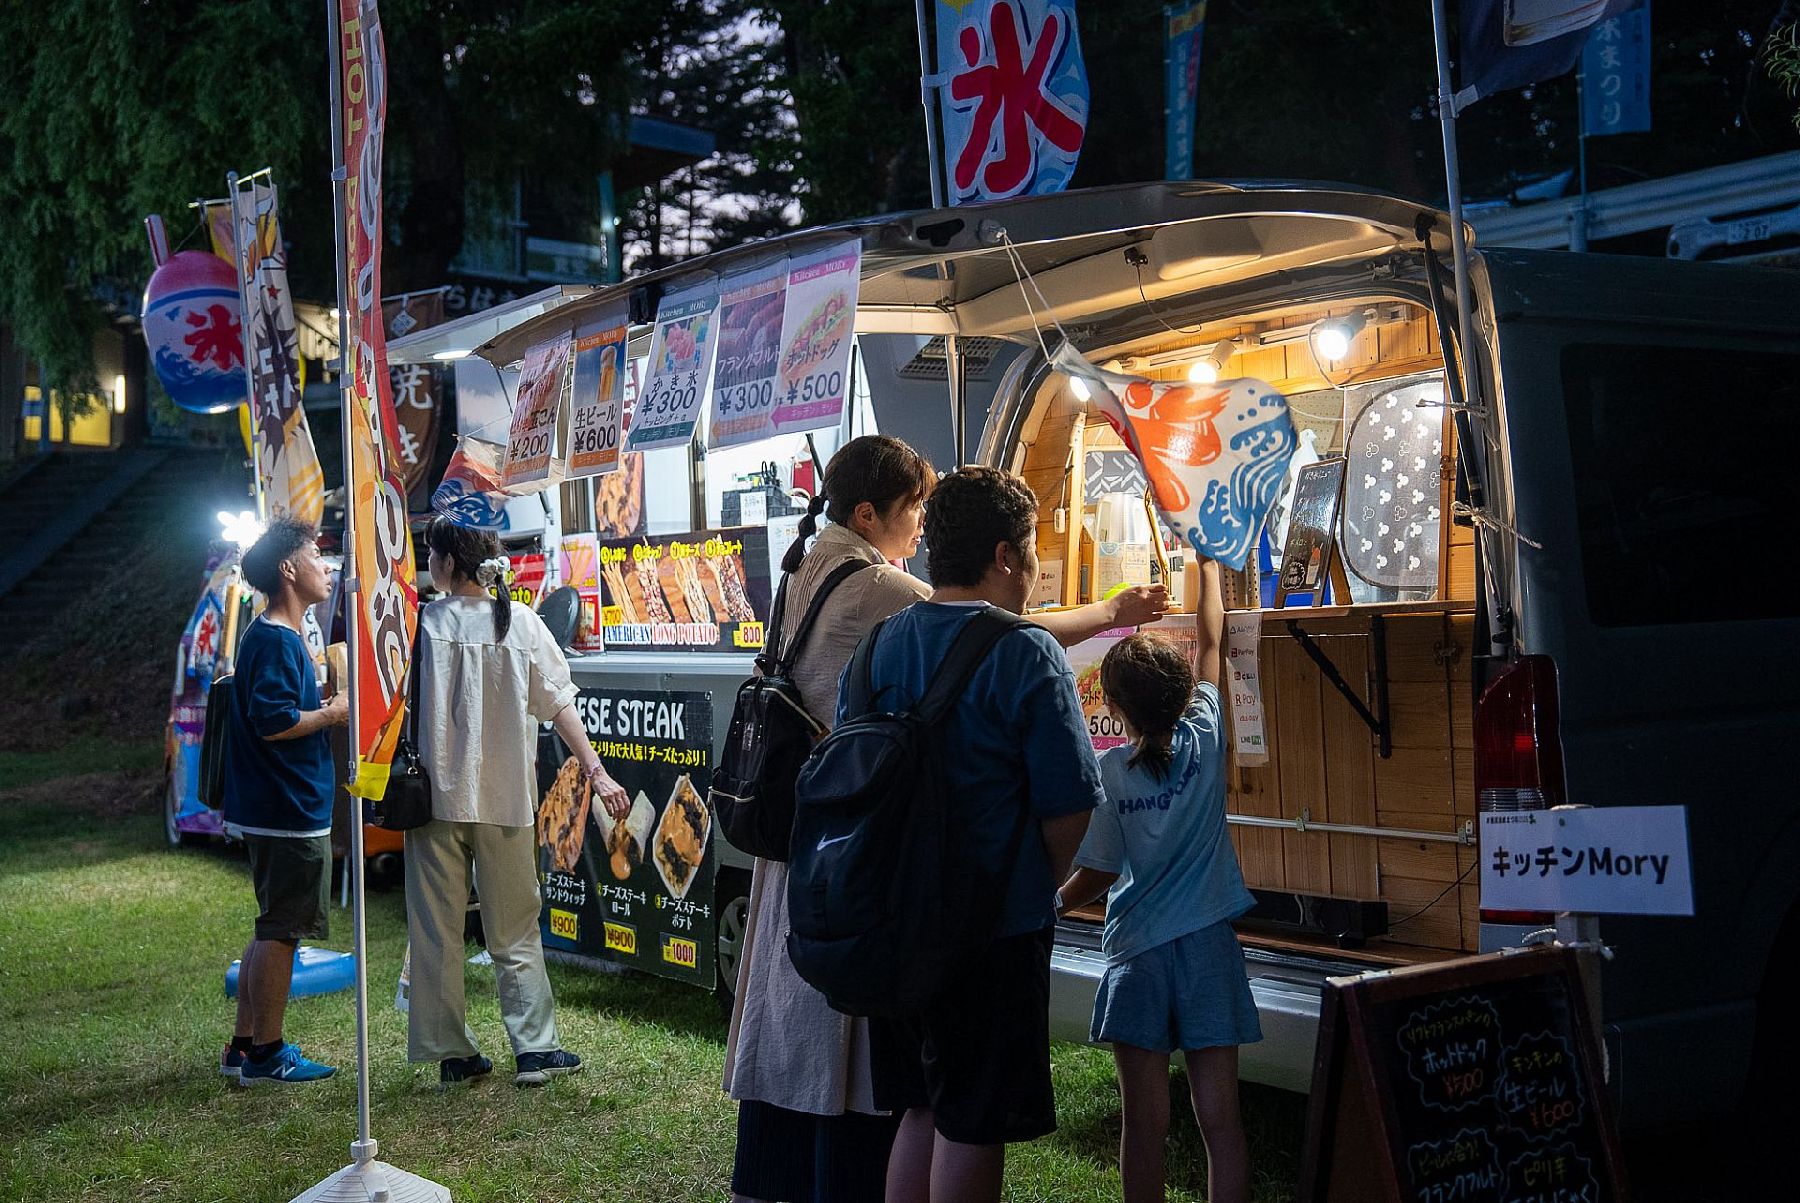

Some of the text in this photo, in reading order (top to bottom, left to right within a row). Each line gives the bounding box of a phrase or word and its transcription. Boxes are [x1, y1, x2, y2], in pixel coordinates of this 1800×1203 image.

[344, 17, 364, 147] HOT
[951, 2, 1084, 194] 氷
[185, 303, 246, 371] 氷
[718, 344, 781, 376] フランクフルト
[652, 370, 698, 394] かき氷
[786, 371, 842, 405] ¥500
[641, 386, 697, 417] ¥300
[719, 380, 773, 415] ¥300
[574, 403, 617, 430] 生ビール
[510, 432, 549, 461] ¥200
[574, 424, 616, 453] ¥600
[605, 624, 651, 644] AMERICAN
[652, 624, 676, 644] LONG
[677, 624, 717, 645] POTATO
[617, 699, 685, 740] STEAK
[1492, 845, 1670, 885] キッチンMory
[602, 884, 647, 905] チーズステーキ
[612, 901, 631, 917] ロール
[661, 896, 711, 918] チーズステーキ
[552, 914, 576, 935] ¥900
[671, 914, 693, 931] ポテト
[607, 926, 634, 949] ¥900
[1442, 1068, 1484, 1099] ¥500
[1528, 1100, 1575, 1128] ¥600
